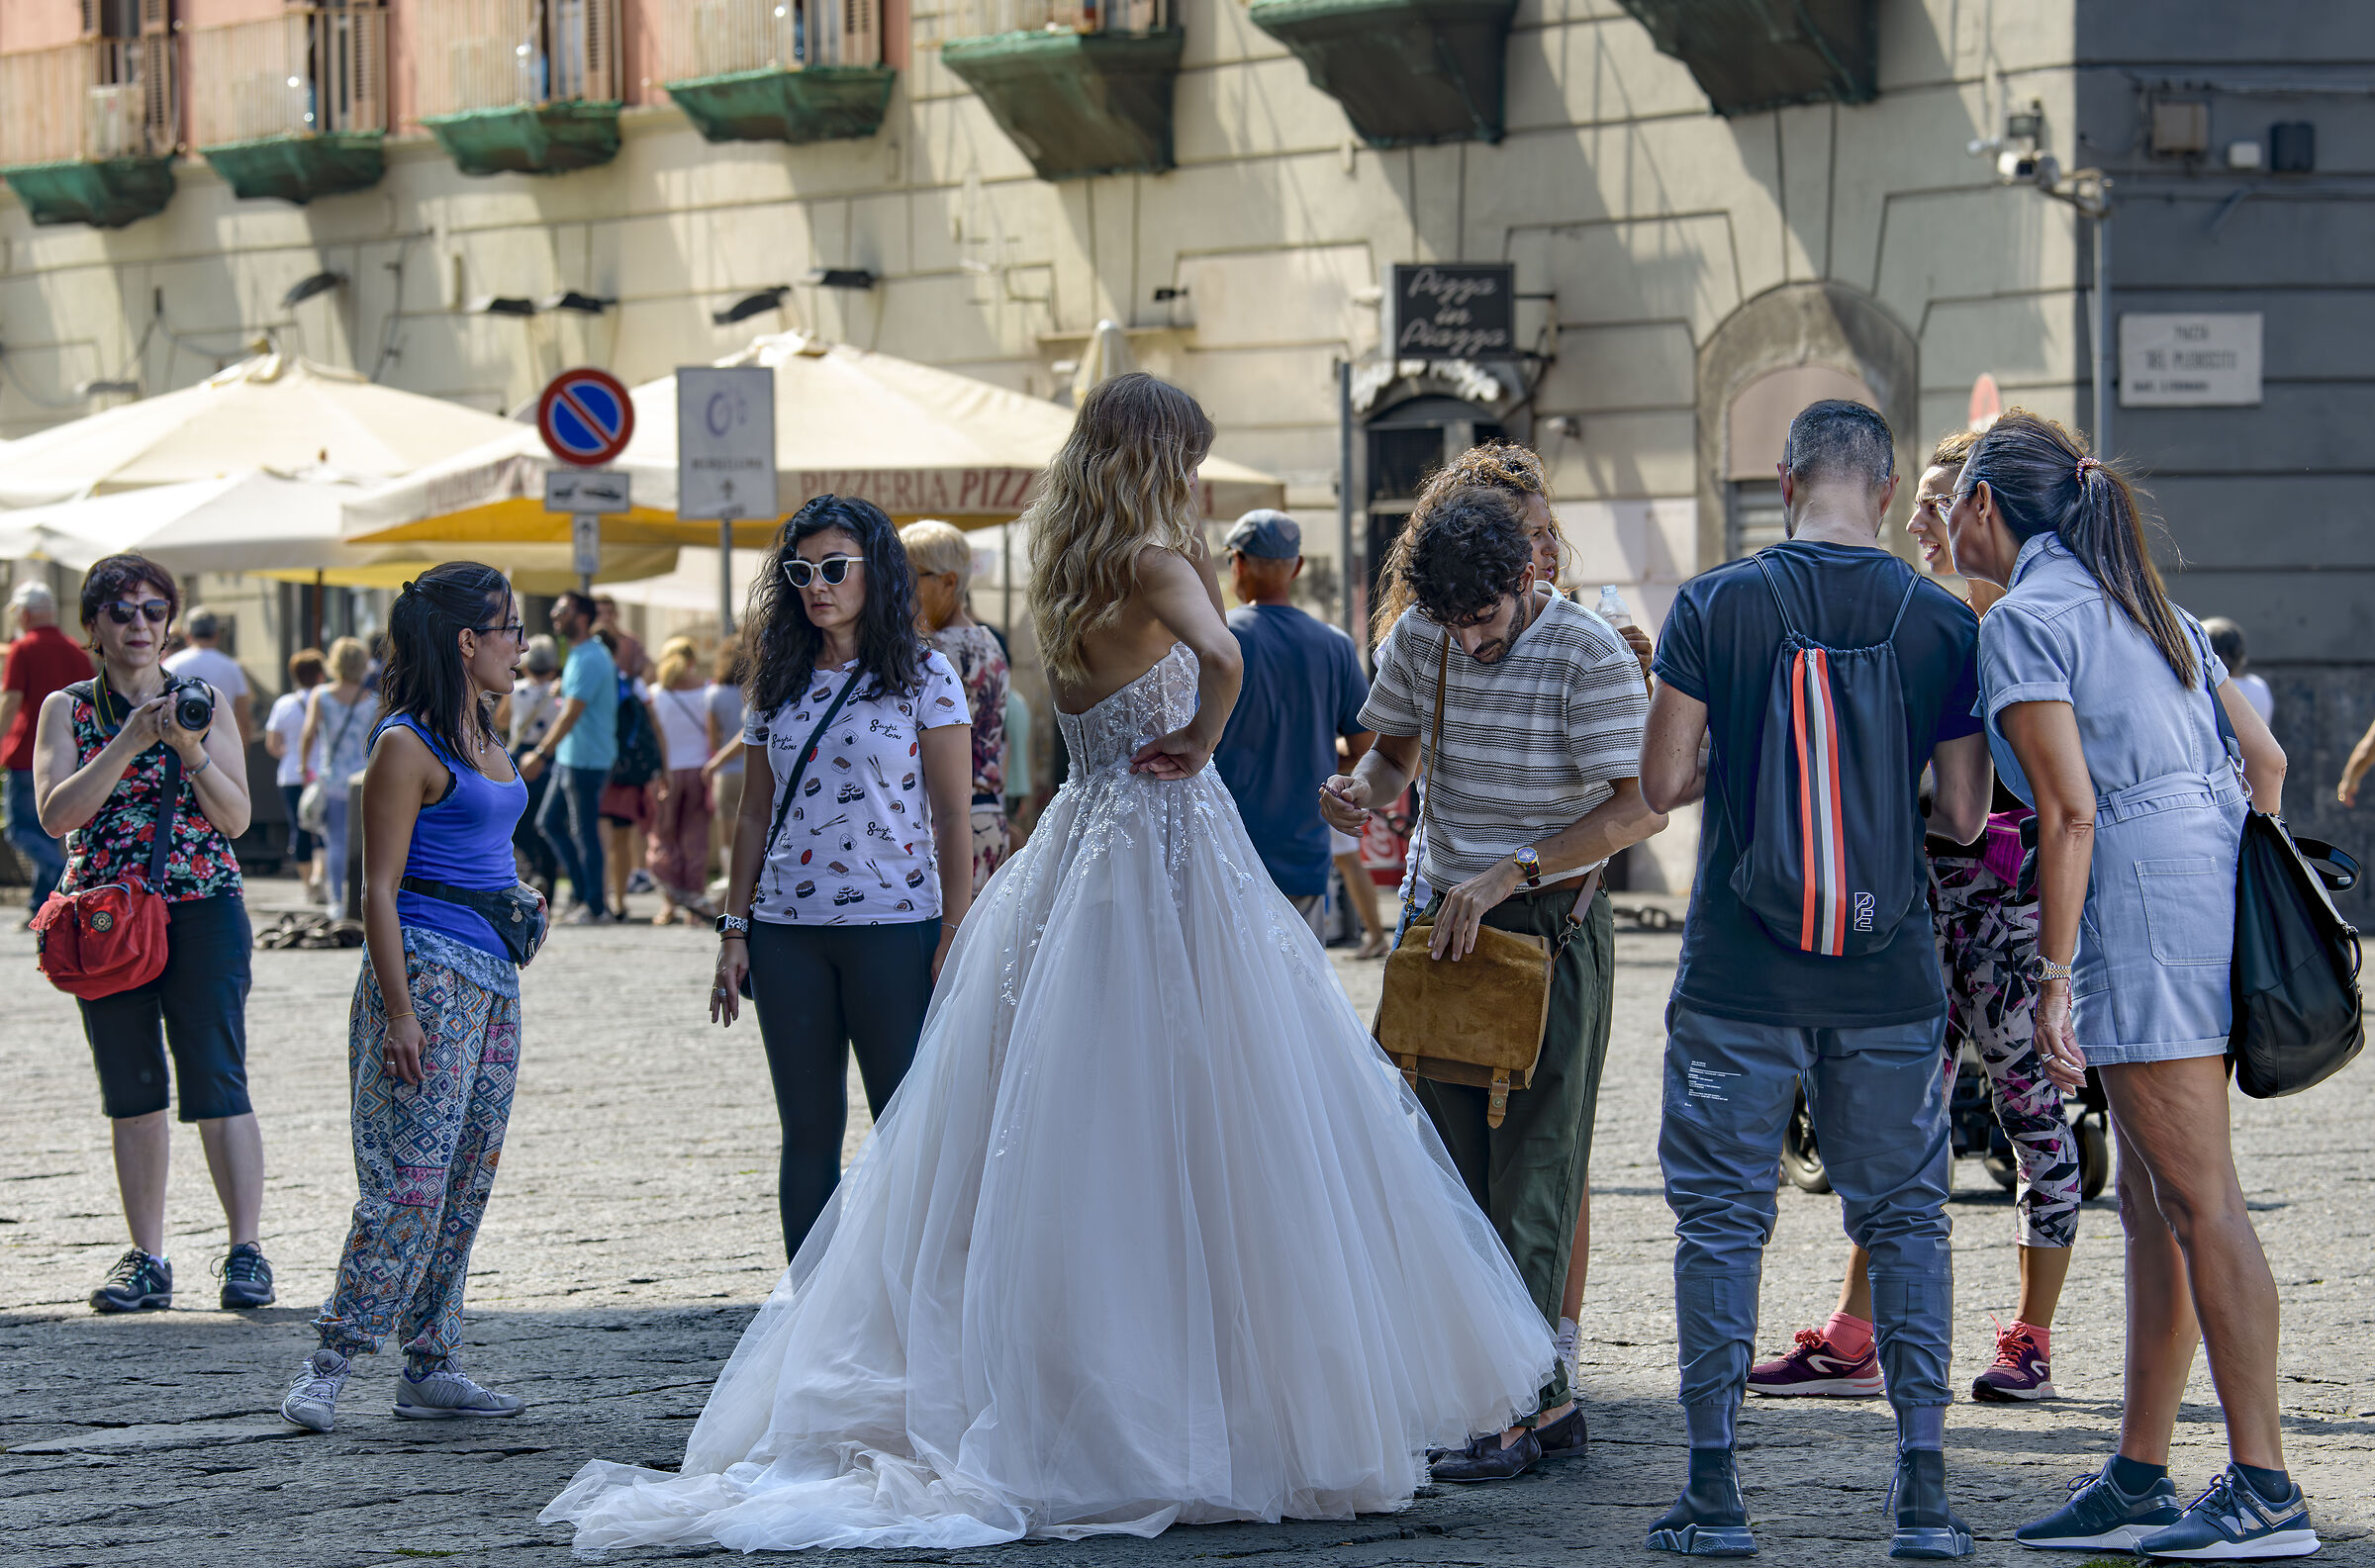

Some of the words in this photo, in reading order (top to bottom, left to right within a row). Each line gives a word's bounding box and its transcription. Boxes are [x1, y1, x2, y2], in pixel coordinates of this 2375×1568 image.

[1407, 267, 1497, 306] Pizza
[1435, 305, 1472, 325] in
[1399, 318, 1508, 356] Piazza
[799, 468, 951, 511] PIZZERIA
[959, 466, 1049, 512] PIZZ
[870, 718, 898, 732] Sushi
